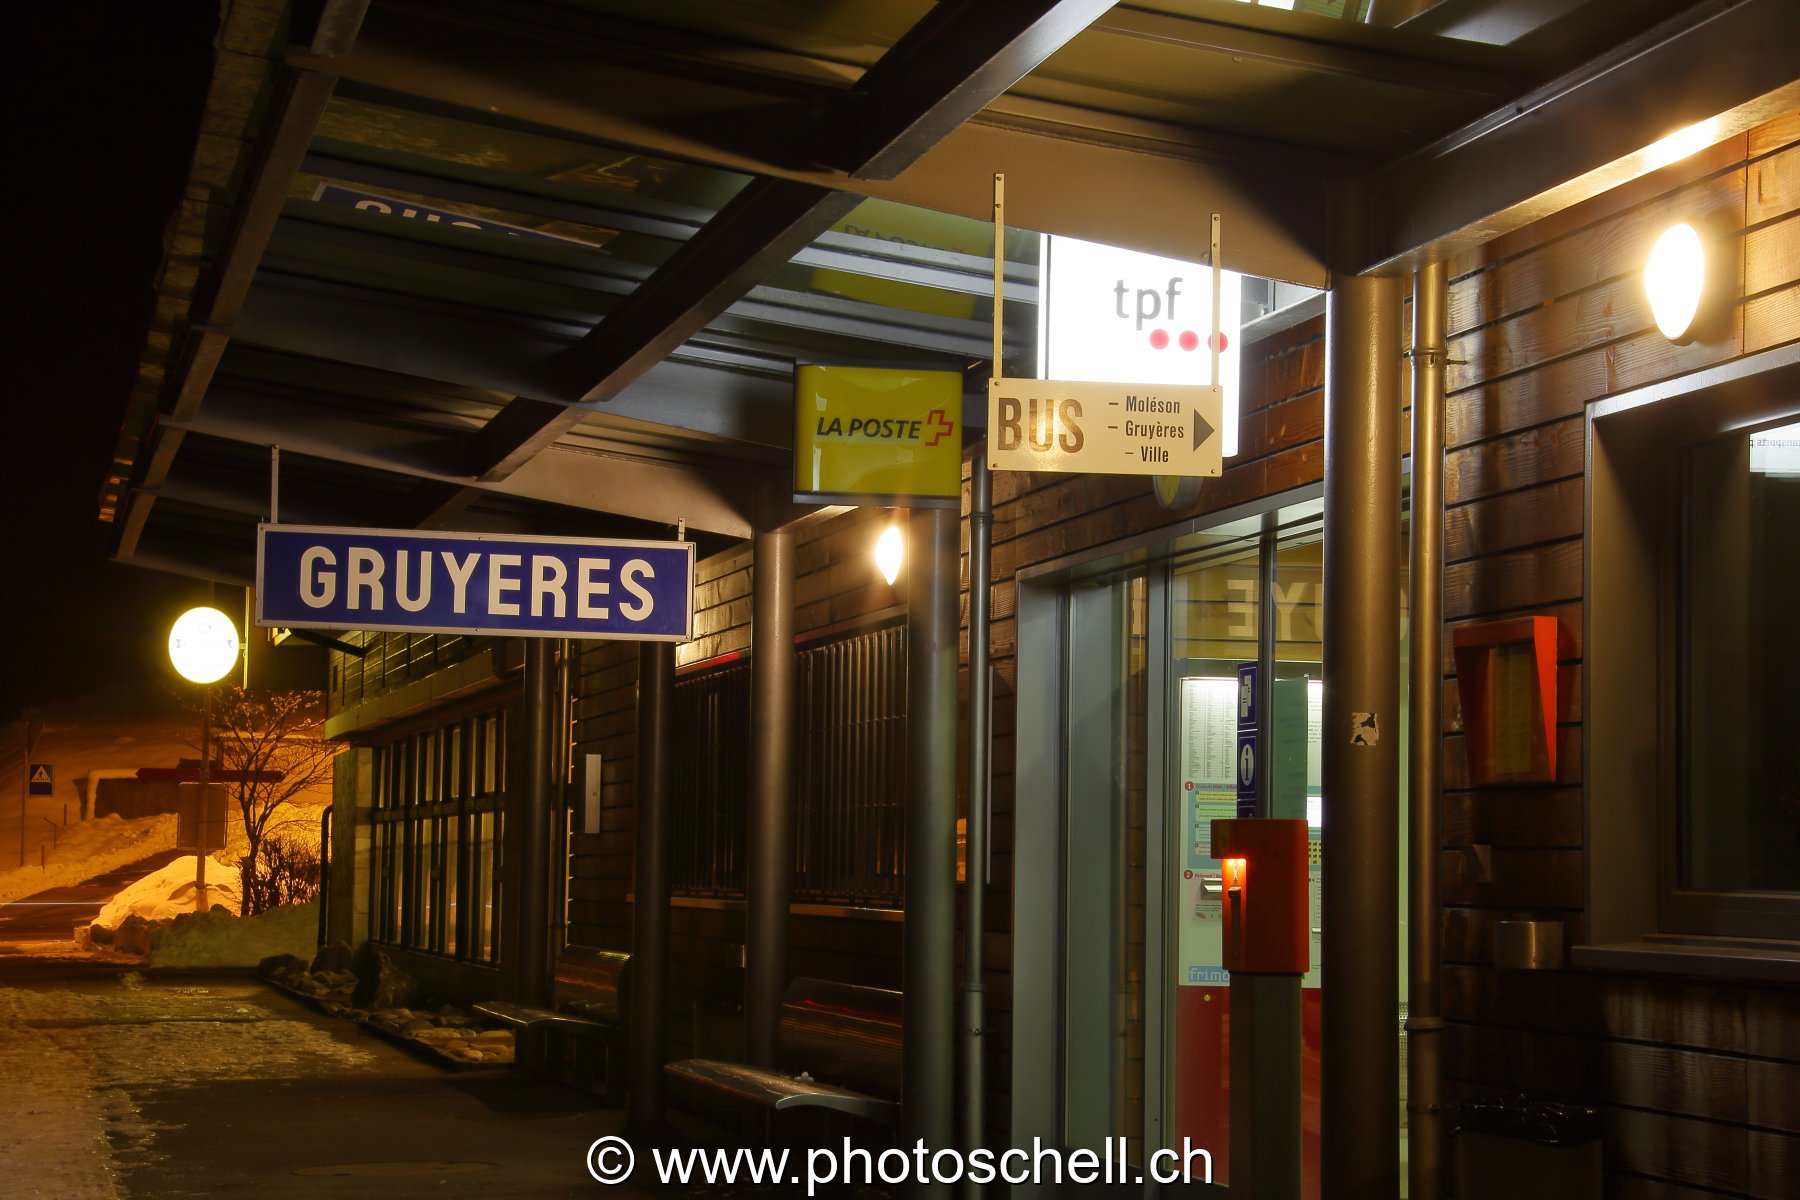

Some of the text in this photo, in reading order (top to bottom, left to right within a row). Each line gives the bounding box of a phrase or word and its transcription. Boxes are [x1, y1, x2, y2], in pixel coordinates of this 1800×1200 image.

[1113, 276, 1184, 331] tpf
[1125, 395, 1181, 414] Moléson
[816, 417, 922, 439] LA POSTE
[997, 396, 1085, 454] BUS
[1125, 420, 1184, 439] Gruyères
[1140, 445, 1169, 463] Ville
[299, 545, 655, 622] GRUYERES
